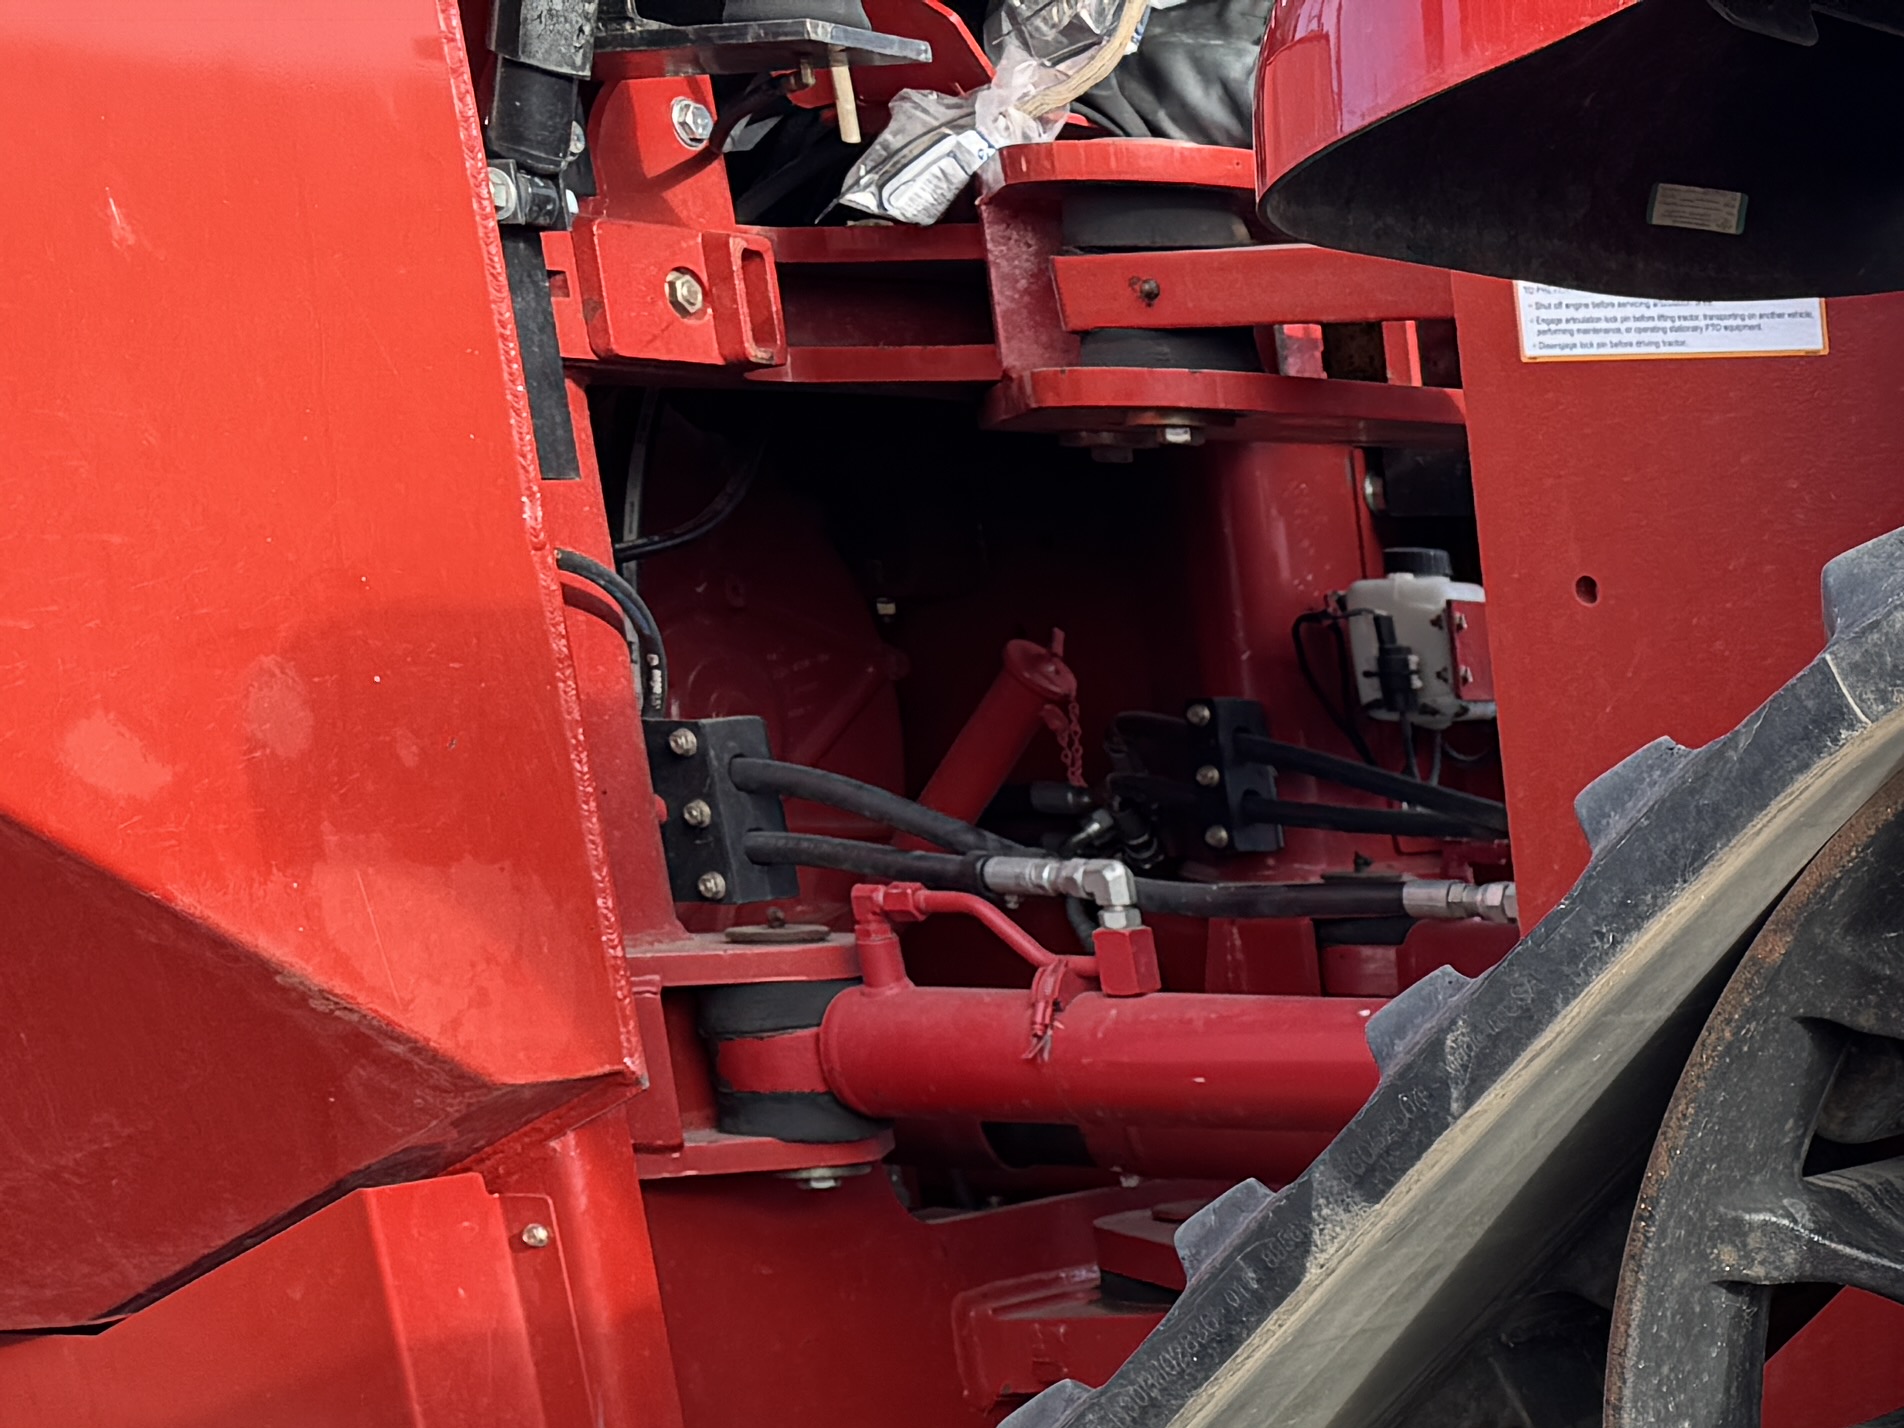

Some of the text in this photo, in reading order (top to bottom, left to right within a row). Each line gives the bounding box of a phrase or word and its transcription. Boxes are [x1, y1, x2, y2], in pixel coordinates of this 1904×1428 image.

[1591, 300, 1615, 309] before
[1617, 300, 1650, 309] servicing
[1632, 313, 1654, 322] before
[1703, 312, 1745, 321] transporting
[1747, 312, 1756, 320] on
[1758, 310, 1785, 320] another
